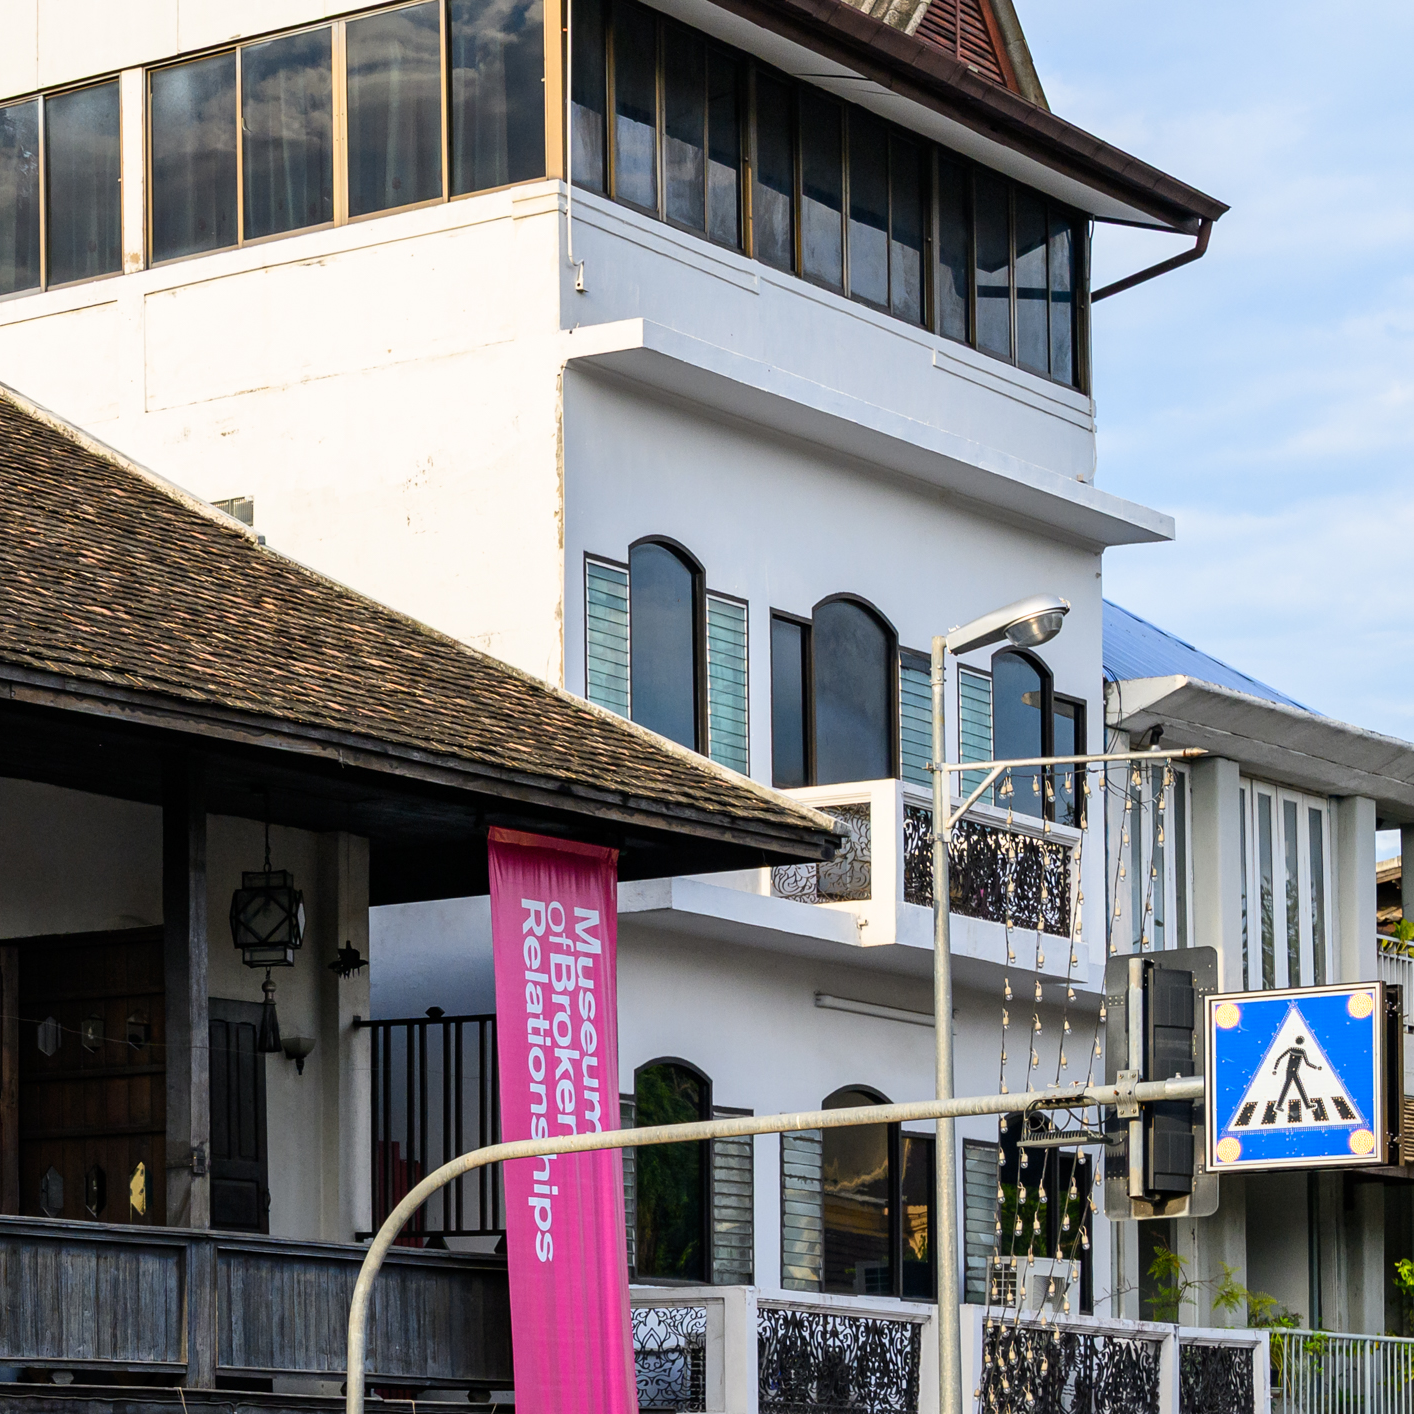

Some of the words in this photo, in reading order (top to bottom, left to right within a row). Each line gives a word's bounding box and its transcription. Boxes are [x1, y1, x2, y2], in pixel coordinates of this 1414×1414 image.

[547, 900, 575, 952] of
[573, 906, 603, 1134] Museum
[520, 897, 559, 1263] Relationships
